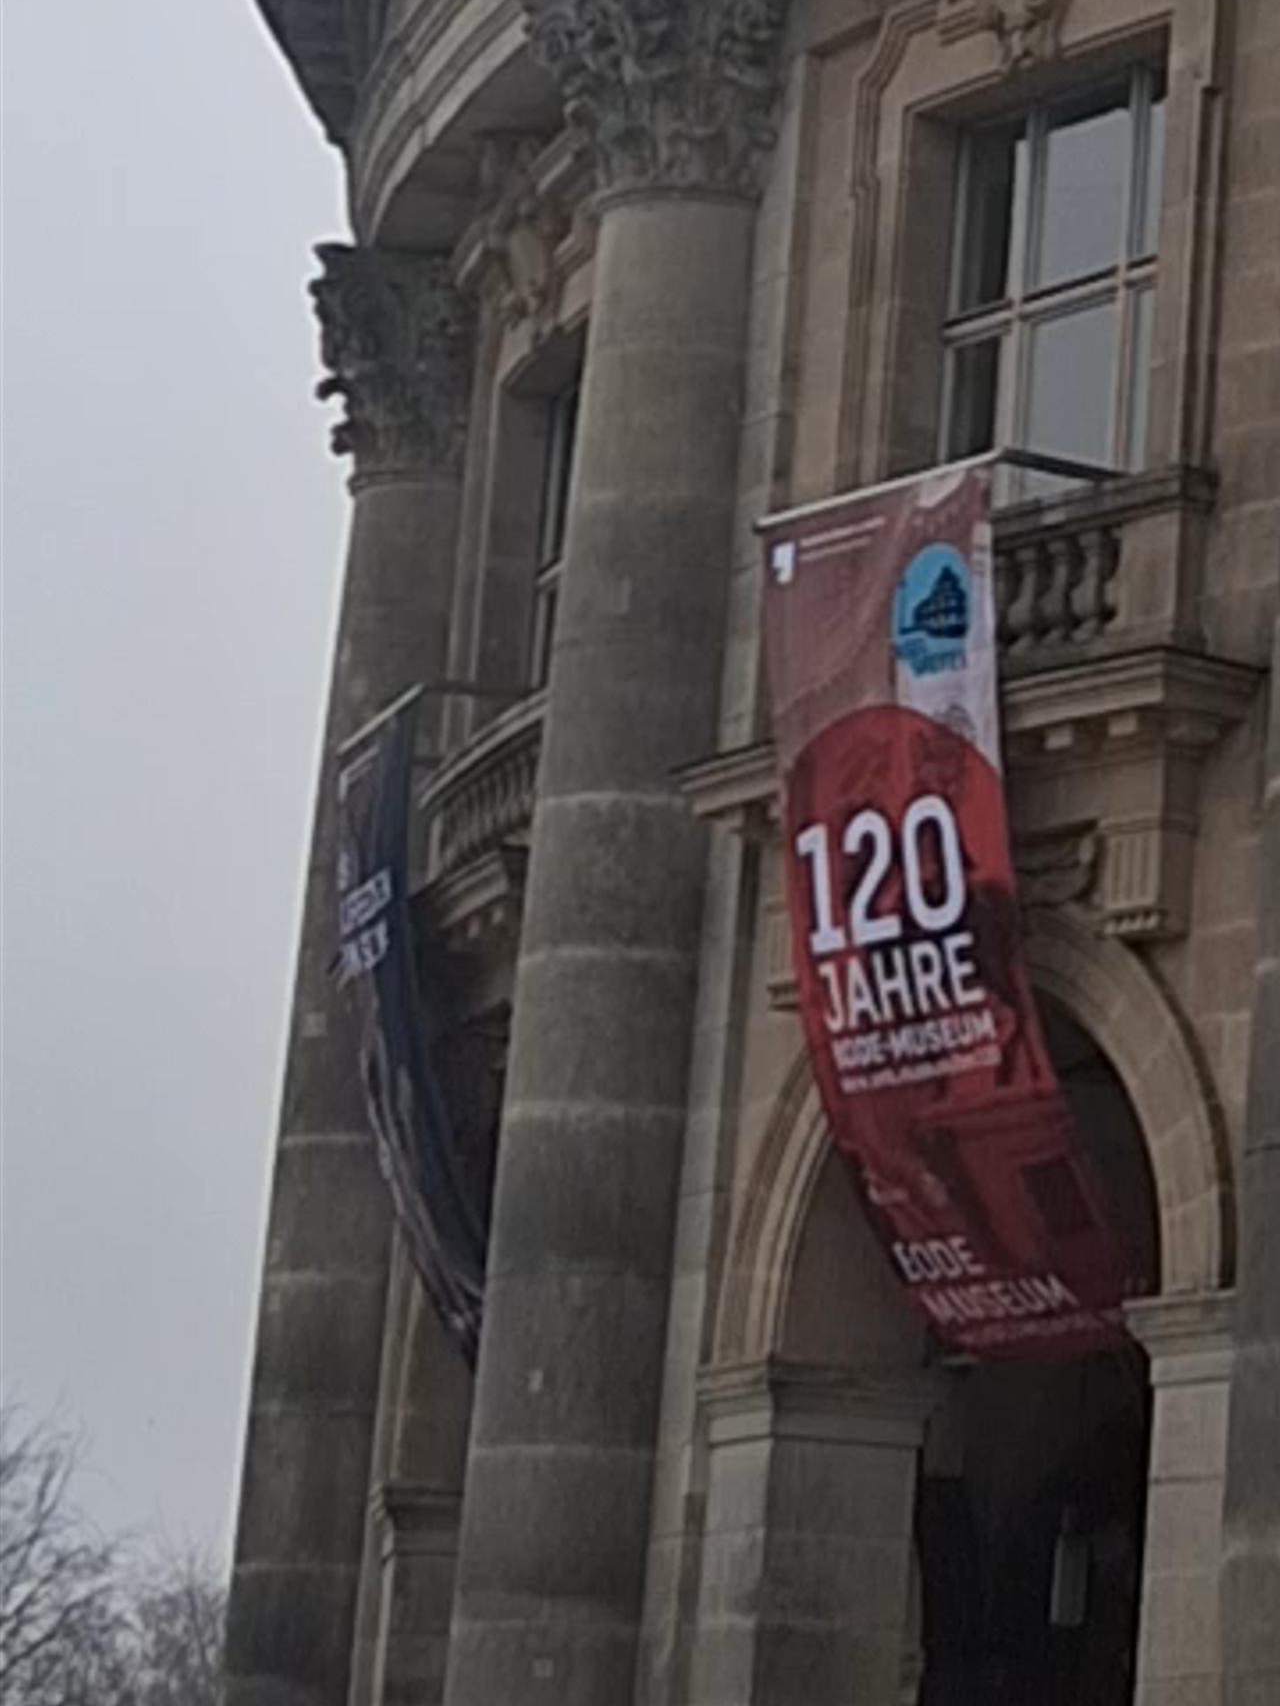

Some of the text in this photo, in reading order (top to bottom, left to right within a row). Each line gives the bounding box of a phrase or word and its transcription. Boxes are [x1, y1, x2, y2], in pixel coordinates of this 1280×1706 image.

[797, 794, 966, 953] 120
[818, 933, 985, 1032] JAHRE
[920, 1276, 1079, 1324] MUSEUM
